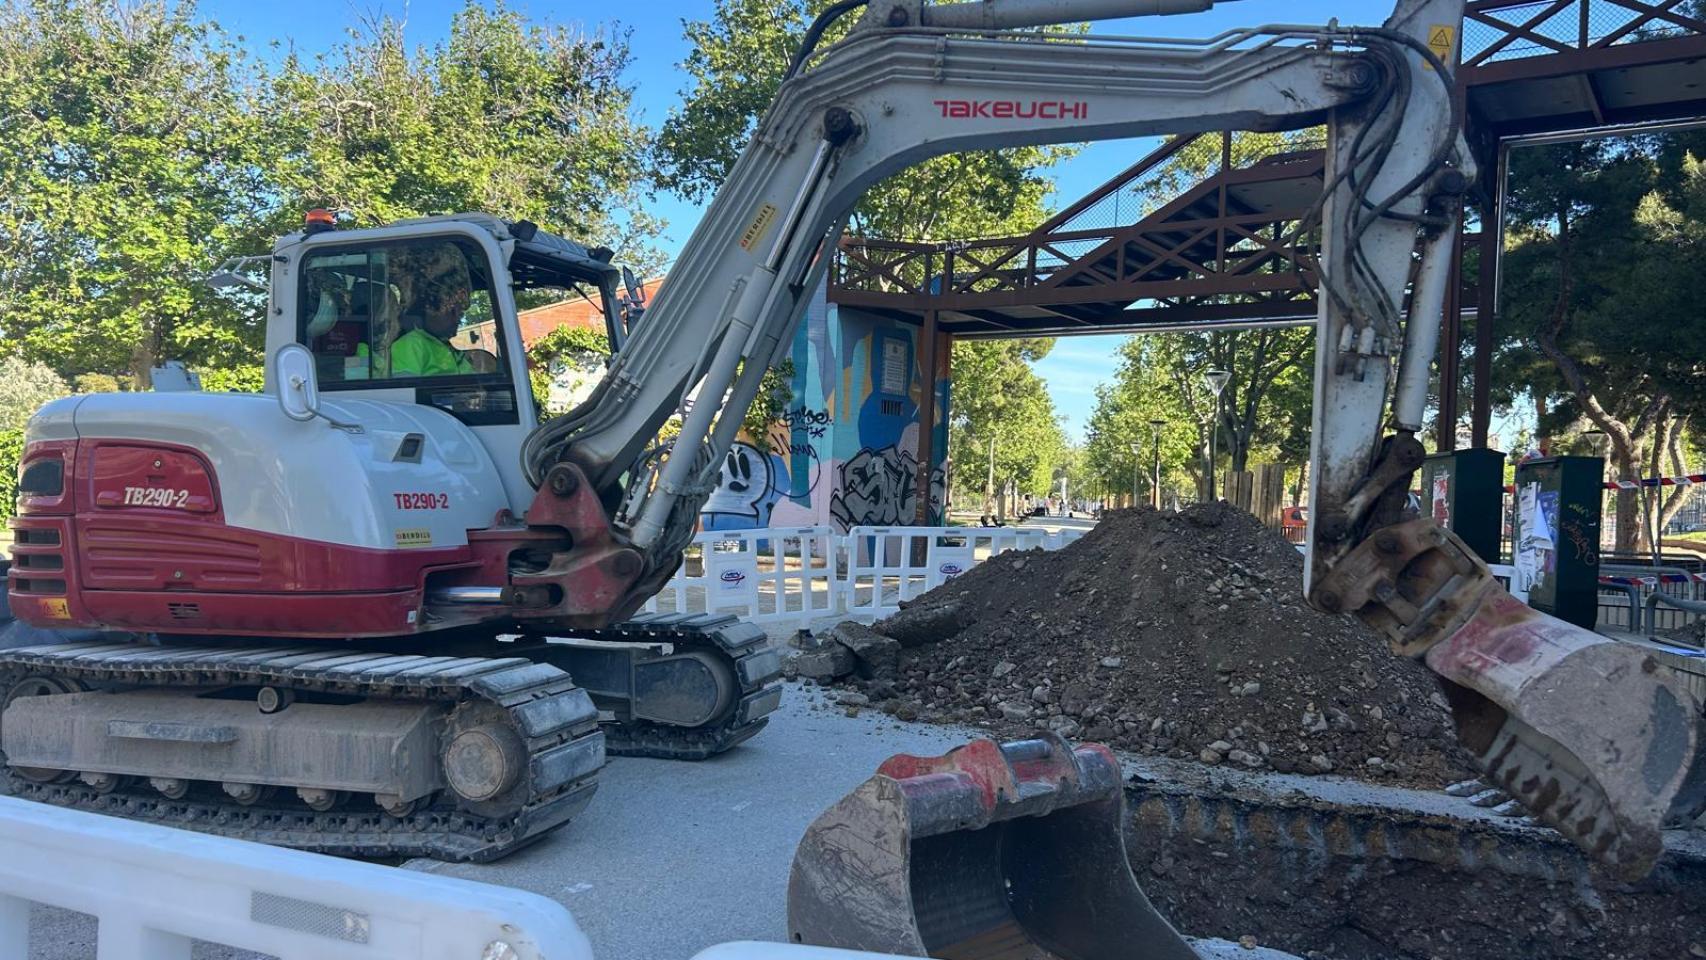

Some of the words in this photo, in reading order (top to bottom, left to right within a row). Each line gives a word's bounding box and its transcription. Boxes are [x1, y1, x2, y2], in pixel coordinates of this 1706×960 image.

[933, 100, 1088, 119] TAKEUCHI
[124, 486, 189, 508] TB290-2
[393, 493, 449, 510] TB290-2
